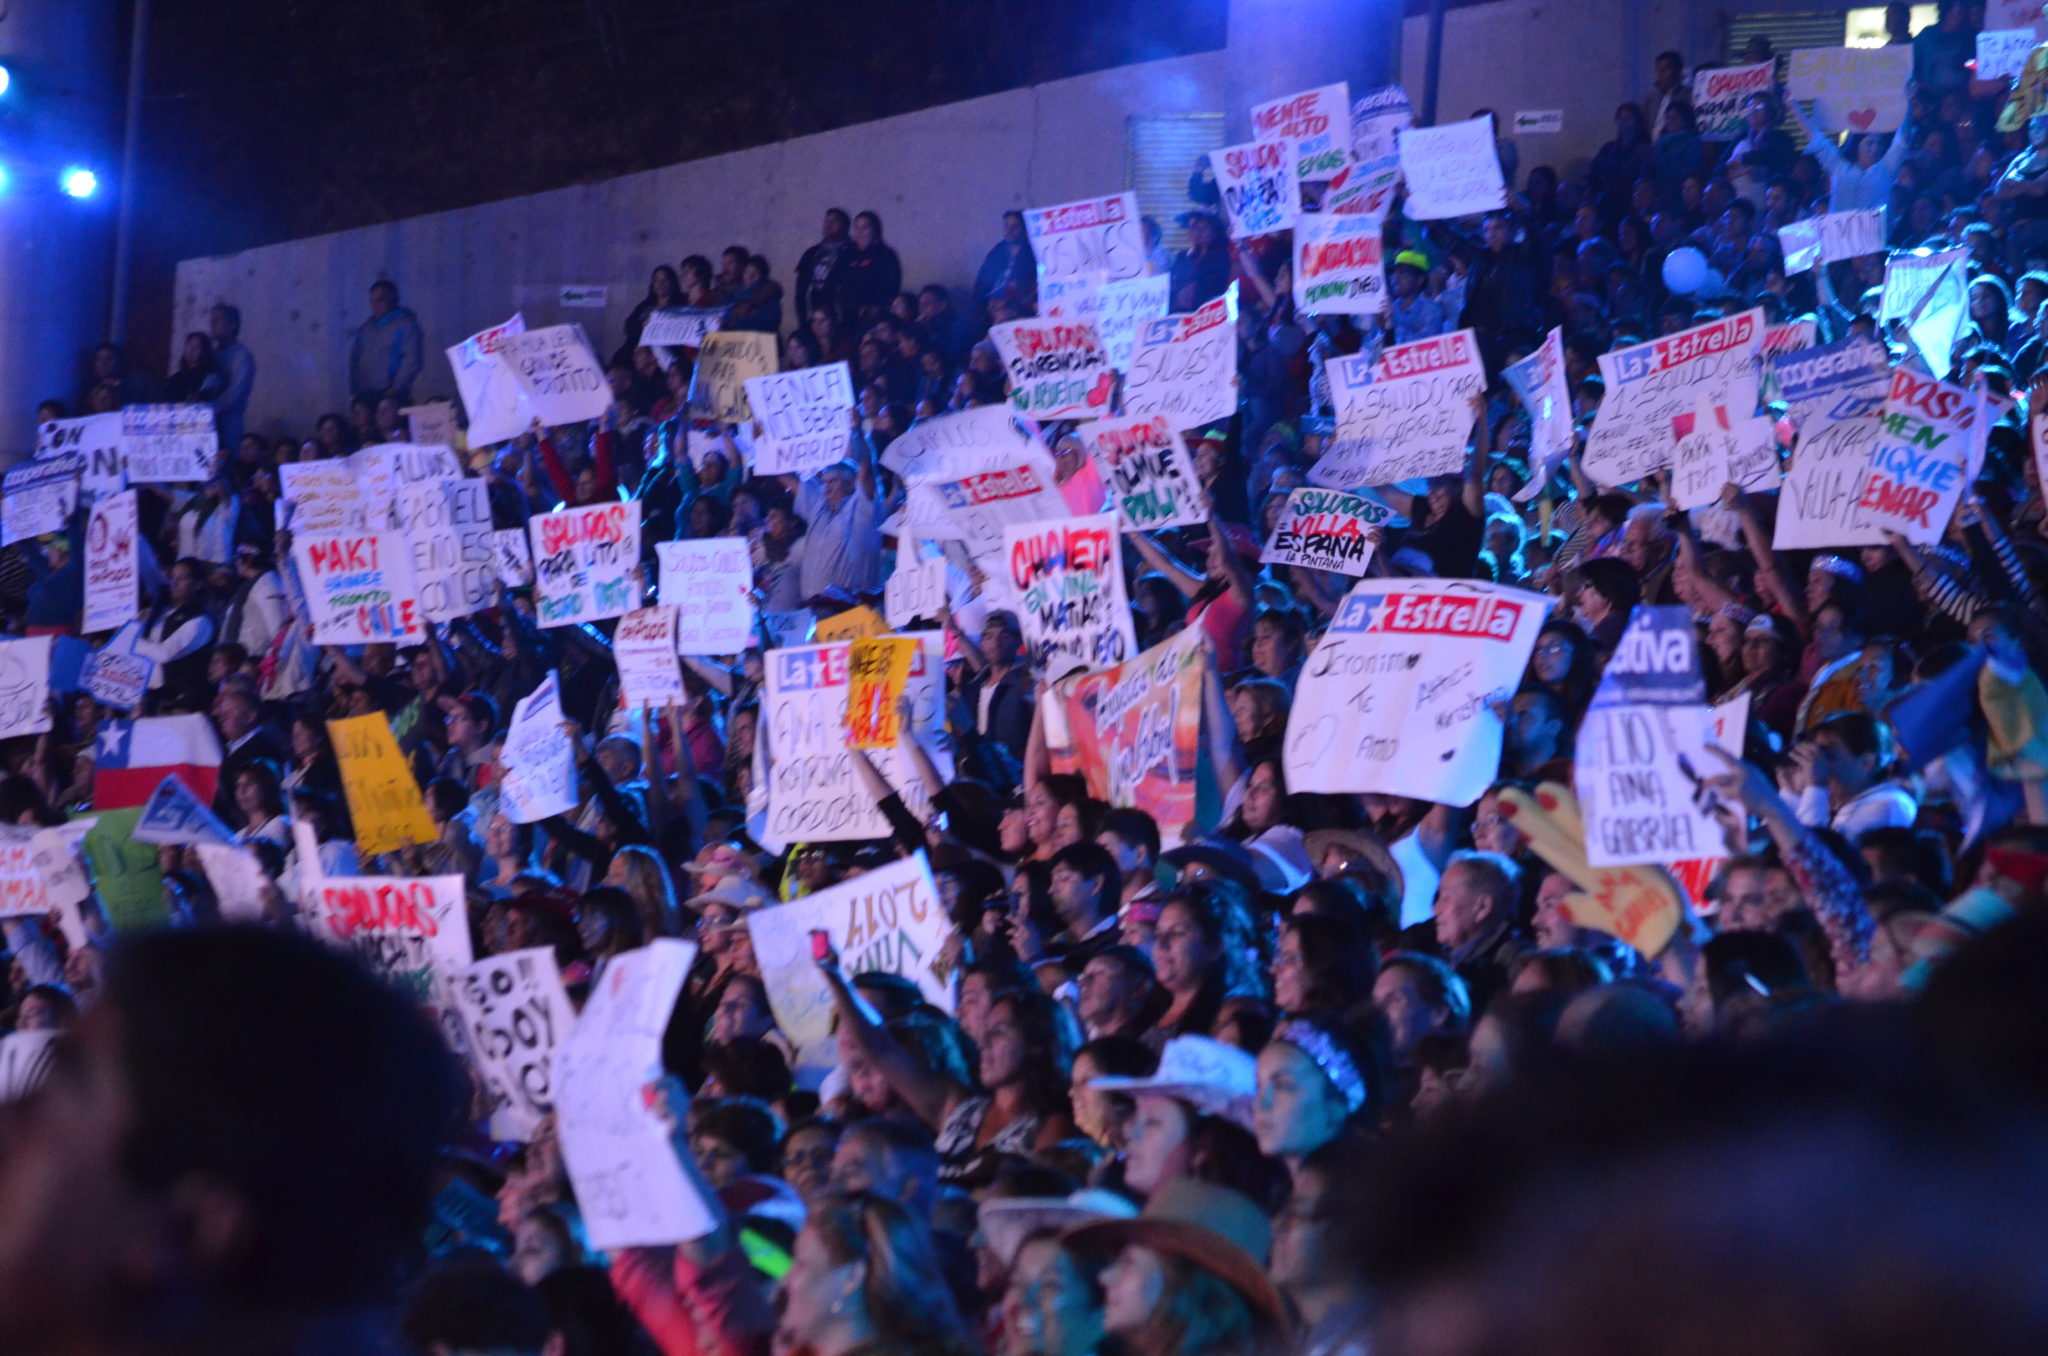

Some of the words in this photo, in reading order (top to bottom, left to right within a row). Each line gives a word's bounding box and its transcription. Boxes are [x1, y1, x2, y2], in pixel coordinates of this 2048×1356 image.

[1386, 336, 1467, 374] Estrella
[1616, 355, 1643, 379] La
[1667, 319, 1751, 363] Estrella
[1292, 514, 1361, 543] VILLA
[1300, 553, 1345, 571] PINTANA
[1333, 600, 1363, 629] La
[1391, 596, 1517, 637] Estrella
[782, 654, 807, 687] La
[1610, 771, 1666, 810] ANA
